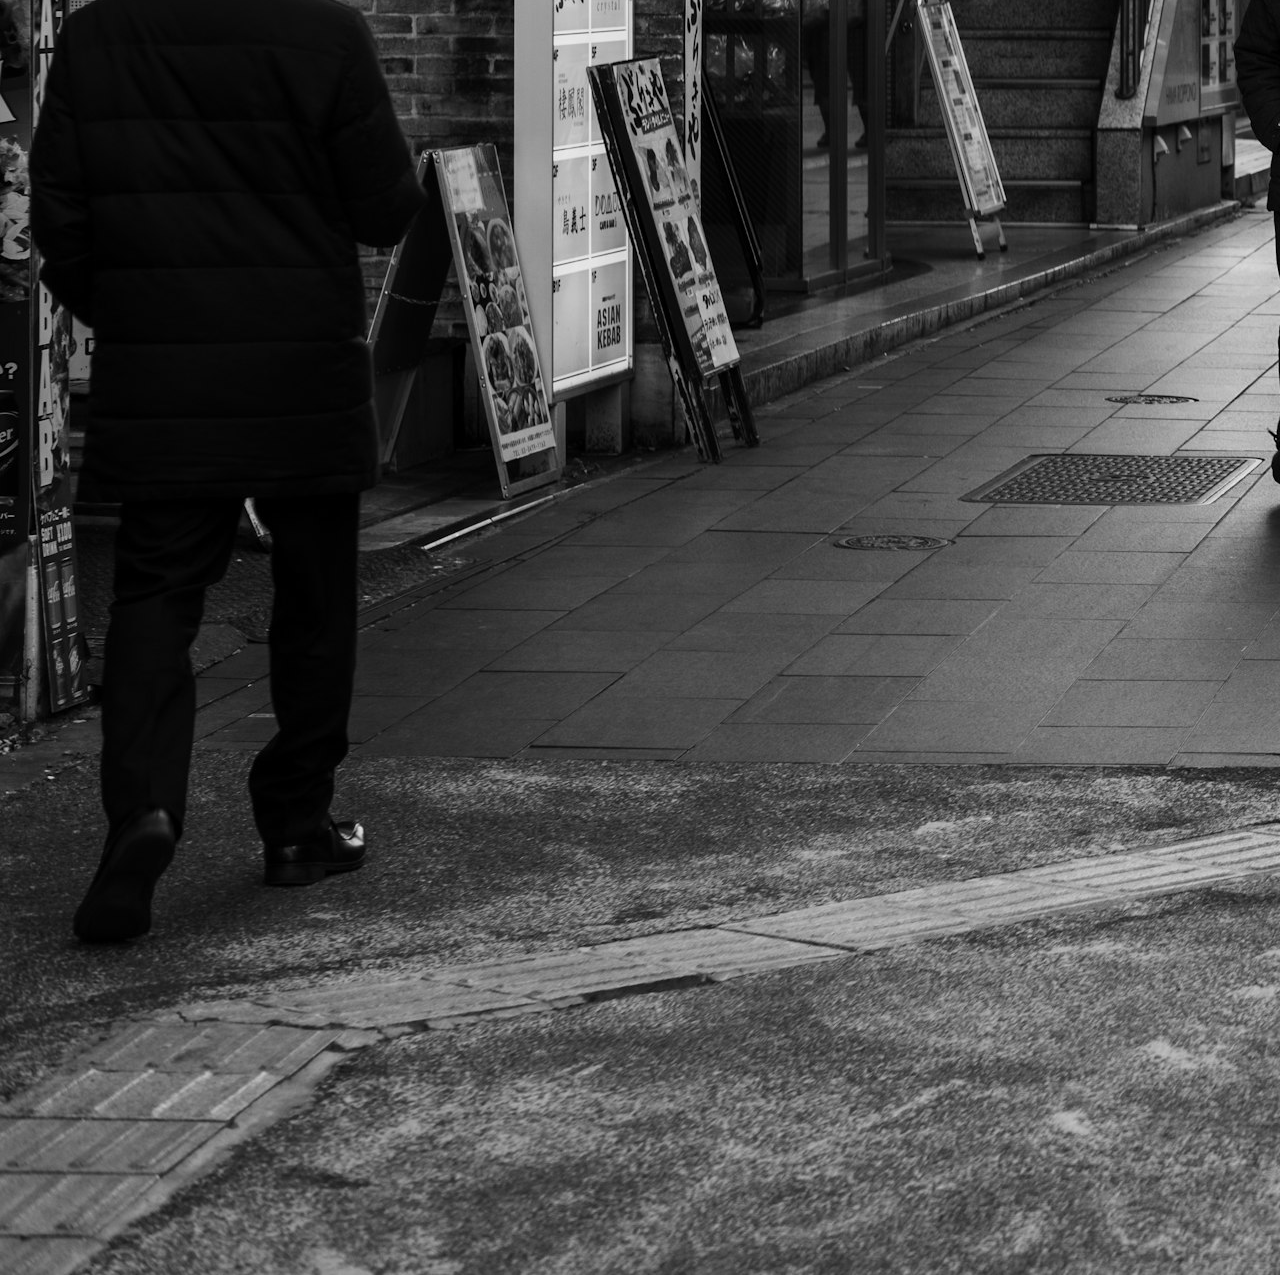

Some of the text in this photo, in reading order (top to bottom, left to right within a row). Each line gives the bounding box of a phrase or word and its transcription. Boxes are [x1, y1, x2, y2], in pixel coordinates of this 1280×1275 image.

[597, 304, 621, 329] ASIAN
[597, 325, 621, 350] KEBAB
[40, 526, 53, 543] SOFT
